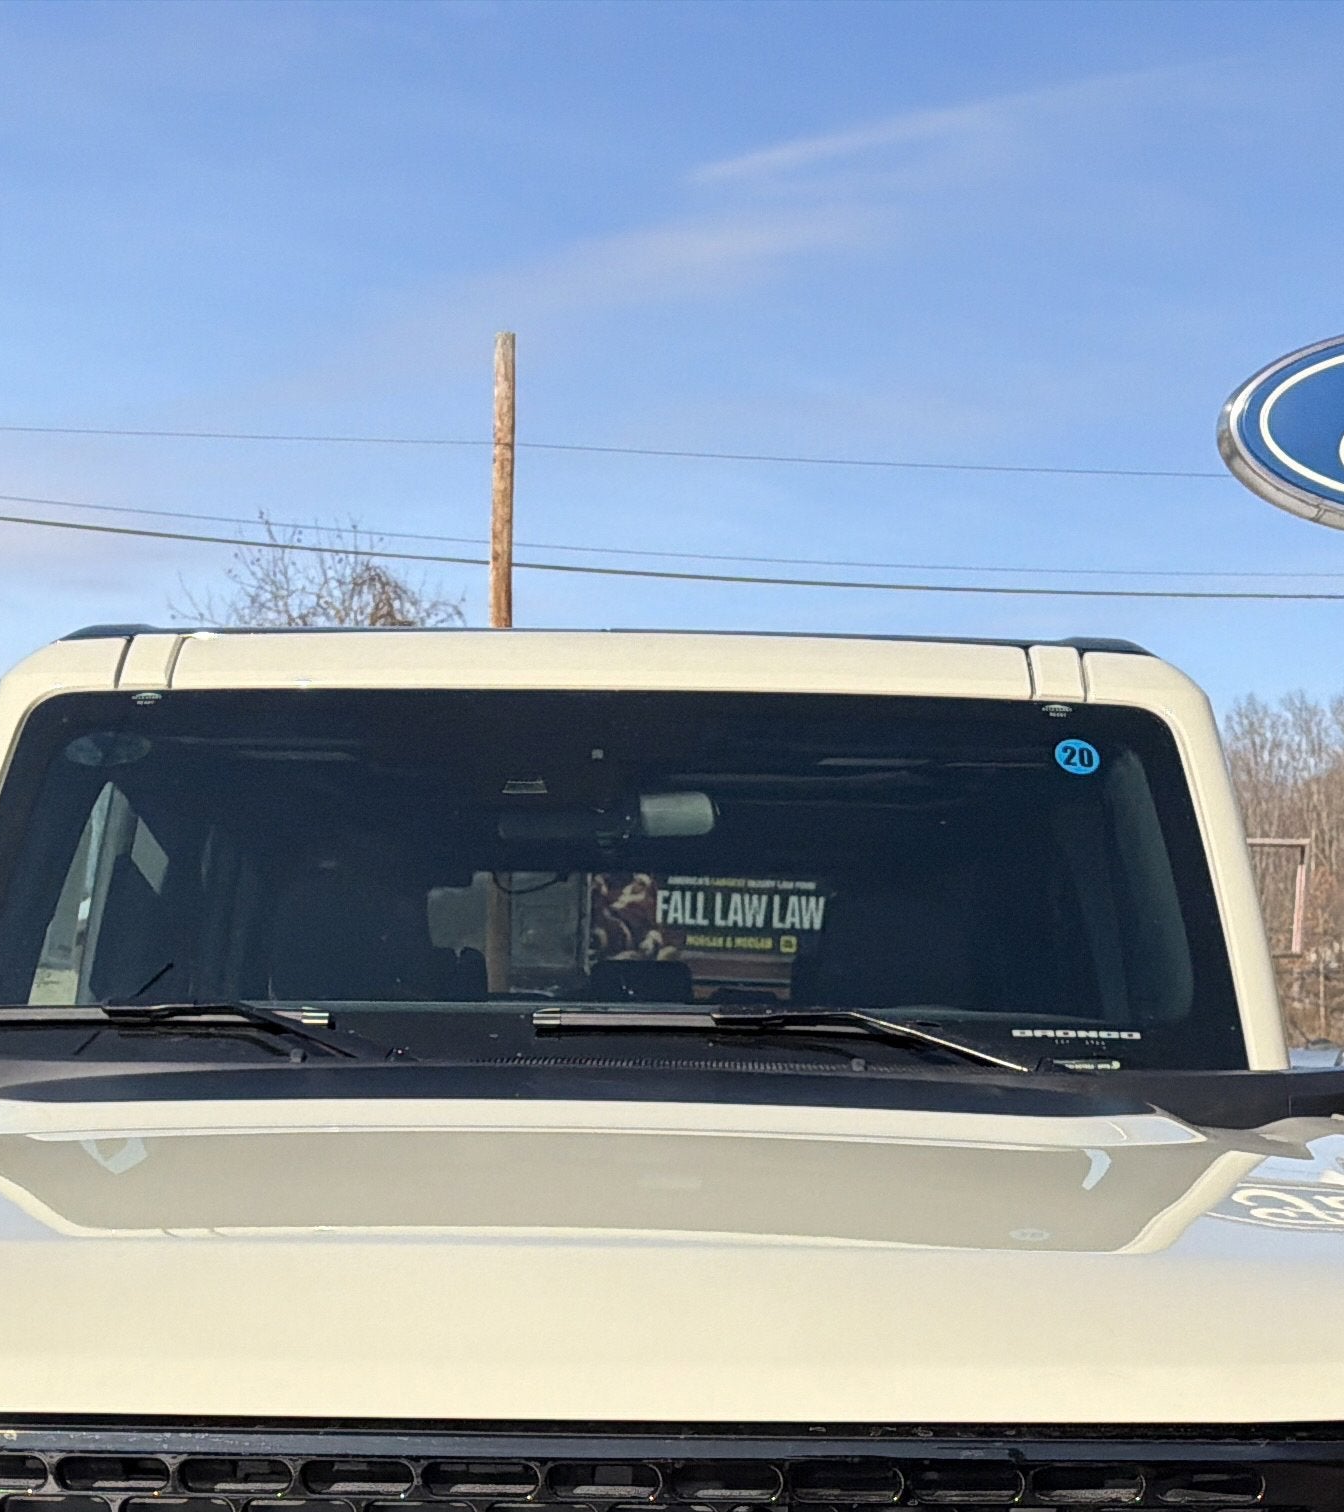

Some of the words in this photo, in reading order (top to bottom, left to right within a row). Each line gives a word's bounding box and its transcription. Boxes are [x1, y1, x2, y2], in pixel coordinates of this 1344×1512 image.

[1061, 745, 1094, 769] 20
[656, 889, 710, 926] FALL
[714, 892, 769, 929] LAW
[772, 894, 826, 931] LAW
